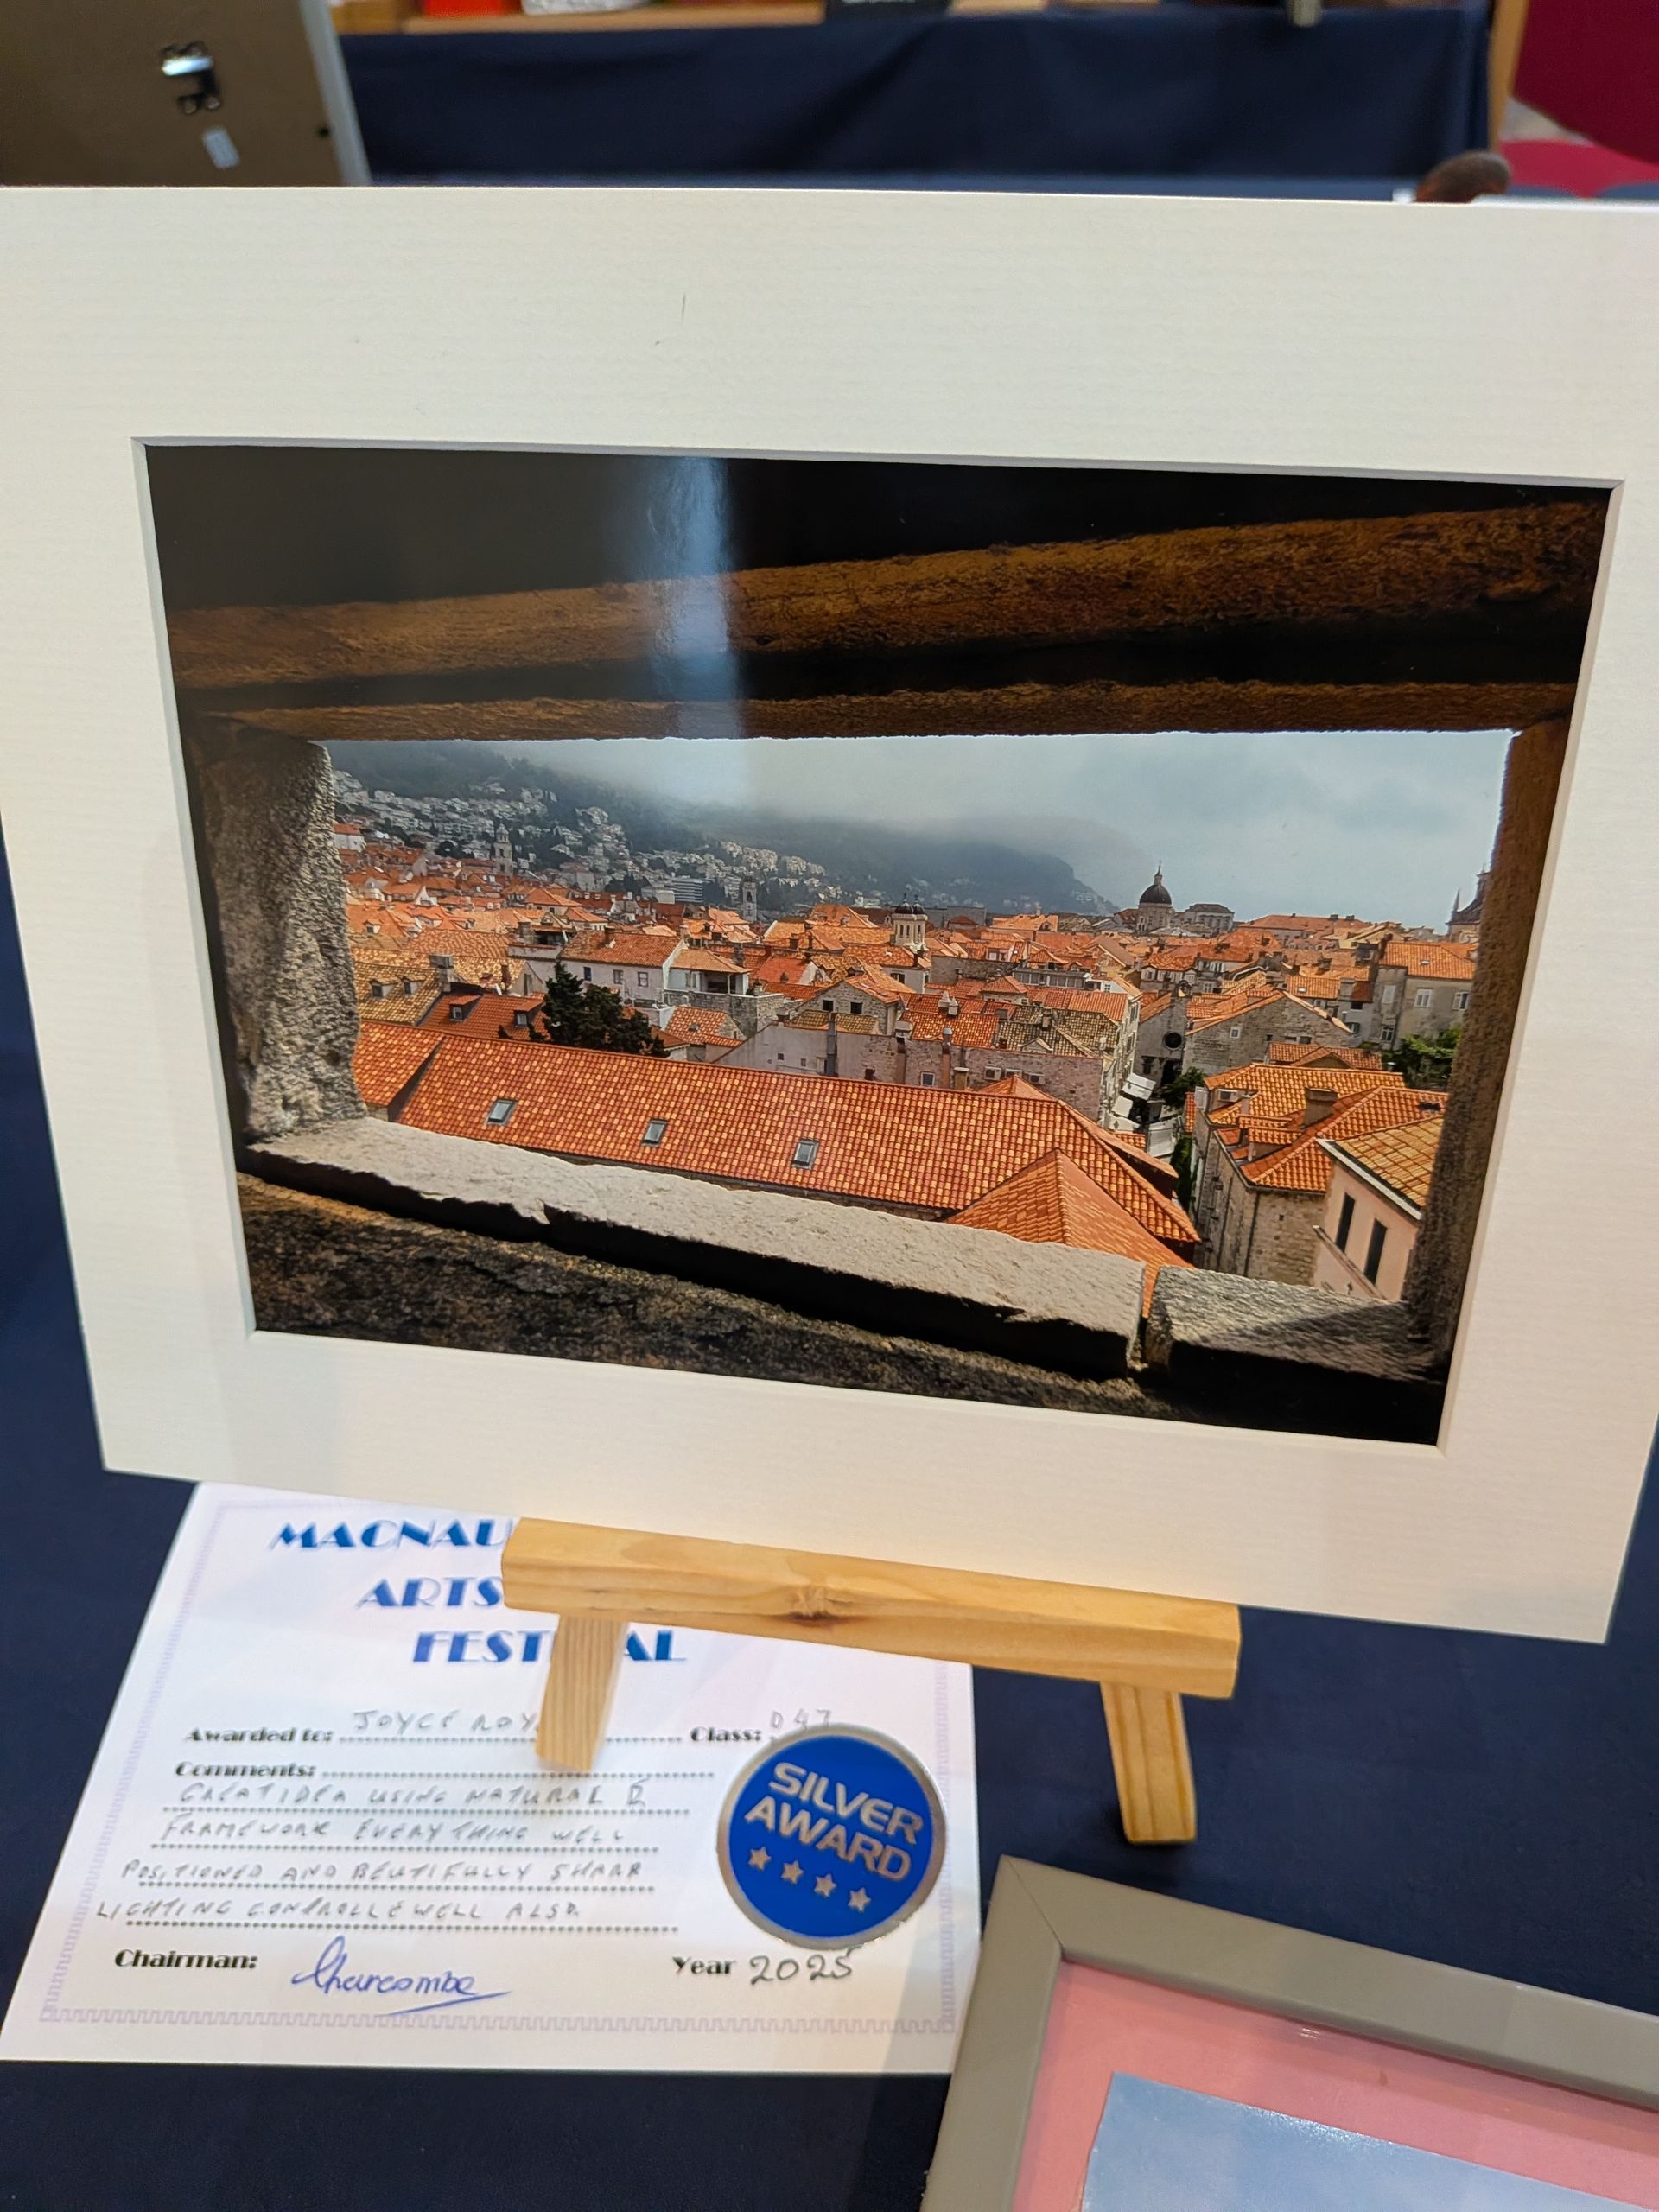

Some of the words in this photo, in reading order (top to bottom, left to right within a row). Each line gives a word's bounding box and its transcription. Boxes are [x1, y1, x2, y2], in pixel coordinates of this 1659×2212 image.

[354, 1576, 504, 1608] ARTS
[412, 1630, 687, 1662] FESTAL
[353, 1709, 460, 1734] JOYCE
[185, 1727, 296, 1743] Awarded
[302, 1729, 334, 1742] to:
[690, 1726, 762, 1743] Class:
[175, 1760, 317, 1777] Comments:
[768, 1761, 925, 1846] SILVER
[743, 1794, 912, 1882] AWARD
[280, 1863, 337, 1882] AND
[97, 1897, 232, 1919] LIGHTING
[114, 1948, 258, 1969] Chairman:
[671, 1955, 735, 1975] Year
[748, 1944, 862, 1986] 2025
